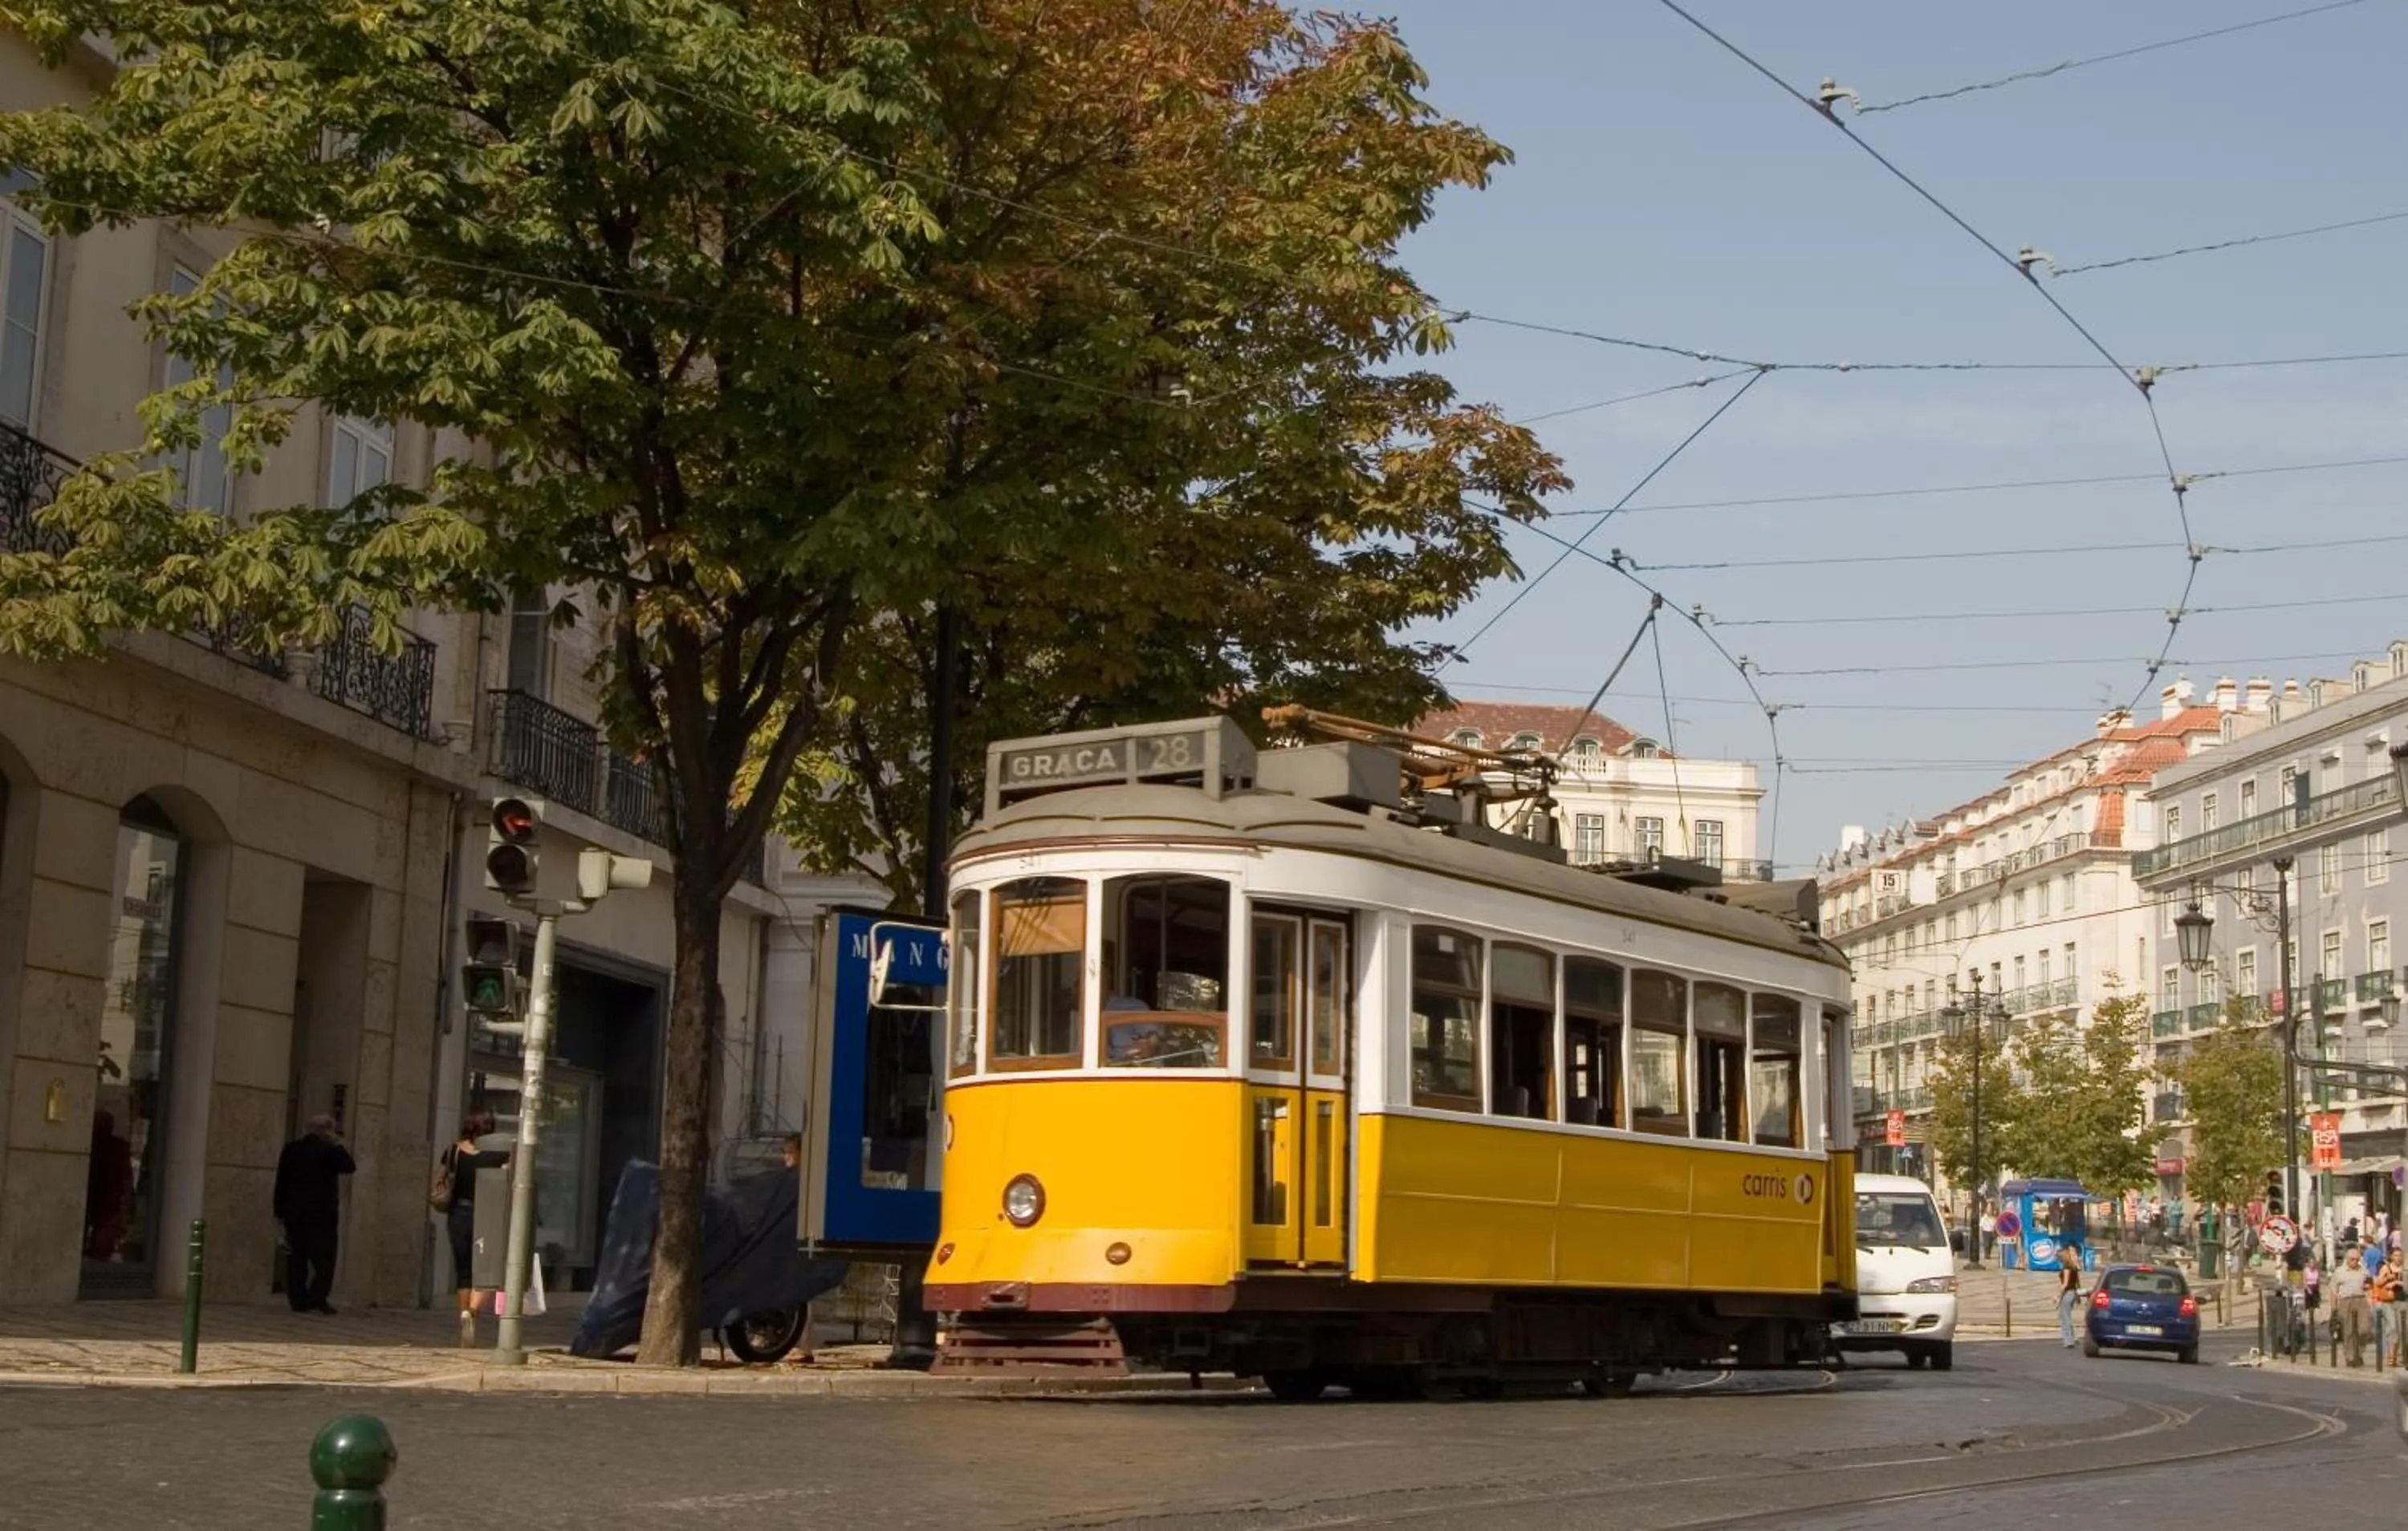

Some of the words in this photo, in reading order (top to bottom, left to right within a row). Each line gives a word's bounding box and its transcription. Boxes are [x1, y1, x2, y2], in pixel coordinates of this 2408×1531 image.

[1149, 736, 1191, 769] 28
[1883, 874, 1895, 887] 15
[1743, 1168, 1786, 1199] carris
